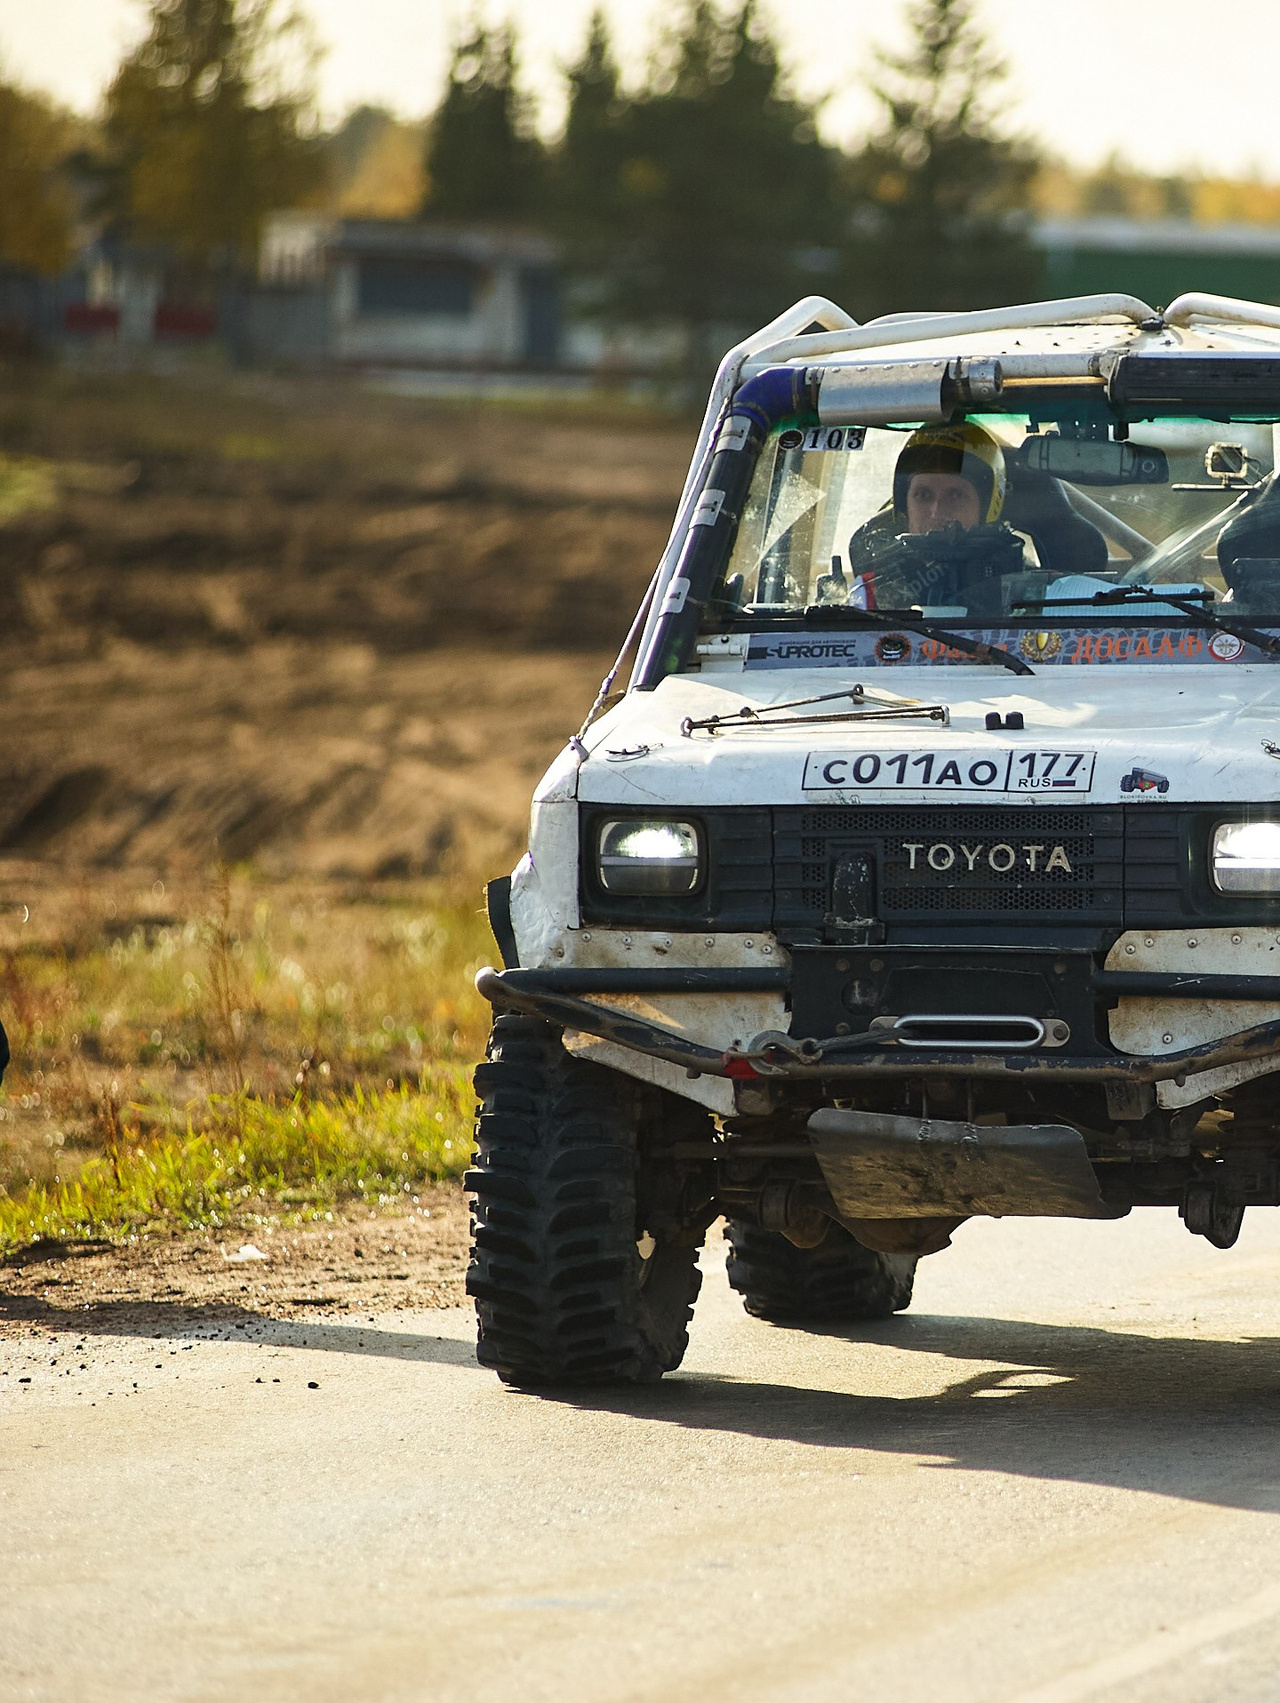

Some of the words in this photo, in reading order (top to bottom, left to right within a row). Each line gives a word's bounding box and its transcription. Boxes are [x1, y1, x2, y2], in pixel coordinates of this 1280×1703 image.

[808, 428, 863, 449] 103
[766, 644, 856, 659] SUPROTEC
[1071, 635, 1203, 664] ДОСААФ
[1018, 752, 1085, 778] 177
[1018, 777, 1051, 788] RUS
[902, 843, 1072, 873] TOYOTA
